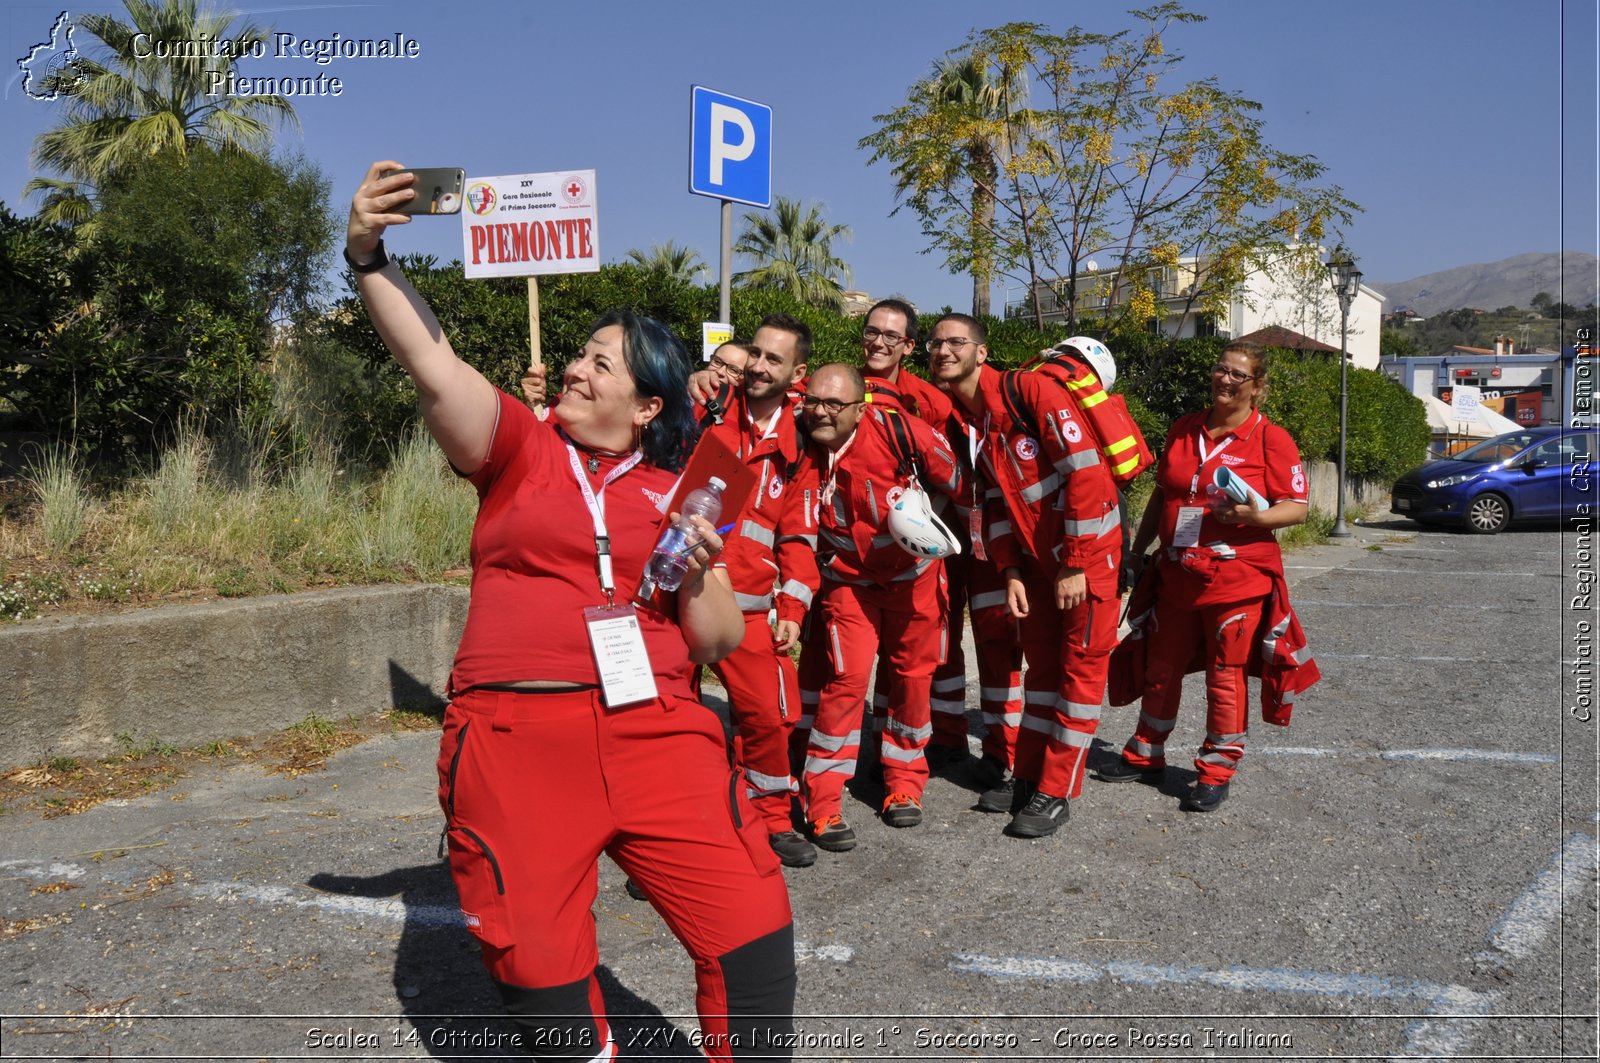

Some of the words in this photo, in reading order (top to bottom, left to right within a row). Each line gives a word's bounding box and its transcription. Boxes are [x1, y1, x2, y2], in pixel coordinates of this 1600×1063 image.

[709, 101, 755, 186] P
[520, 180, 534, 188] XXV
[470, 218, 593, 265] PIEMONTE
